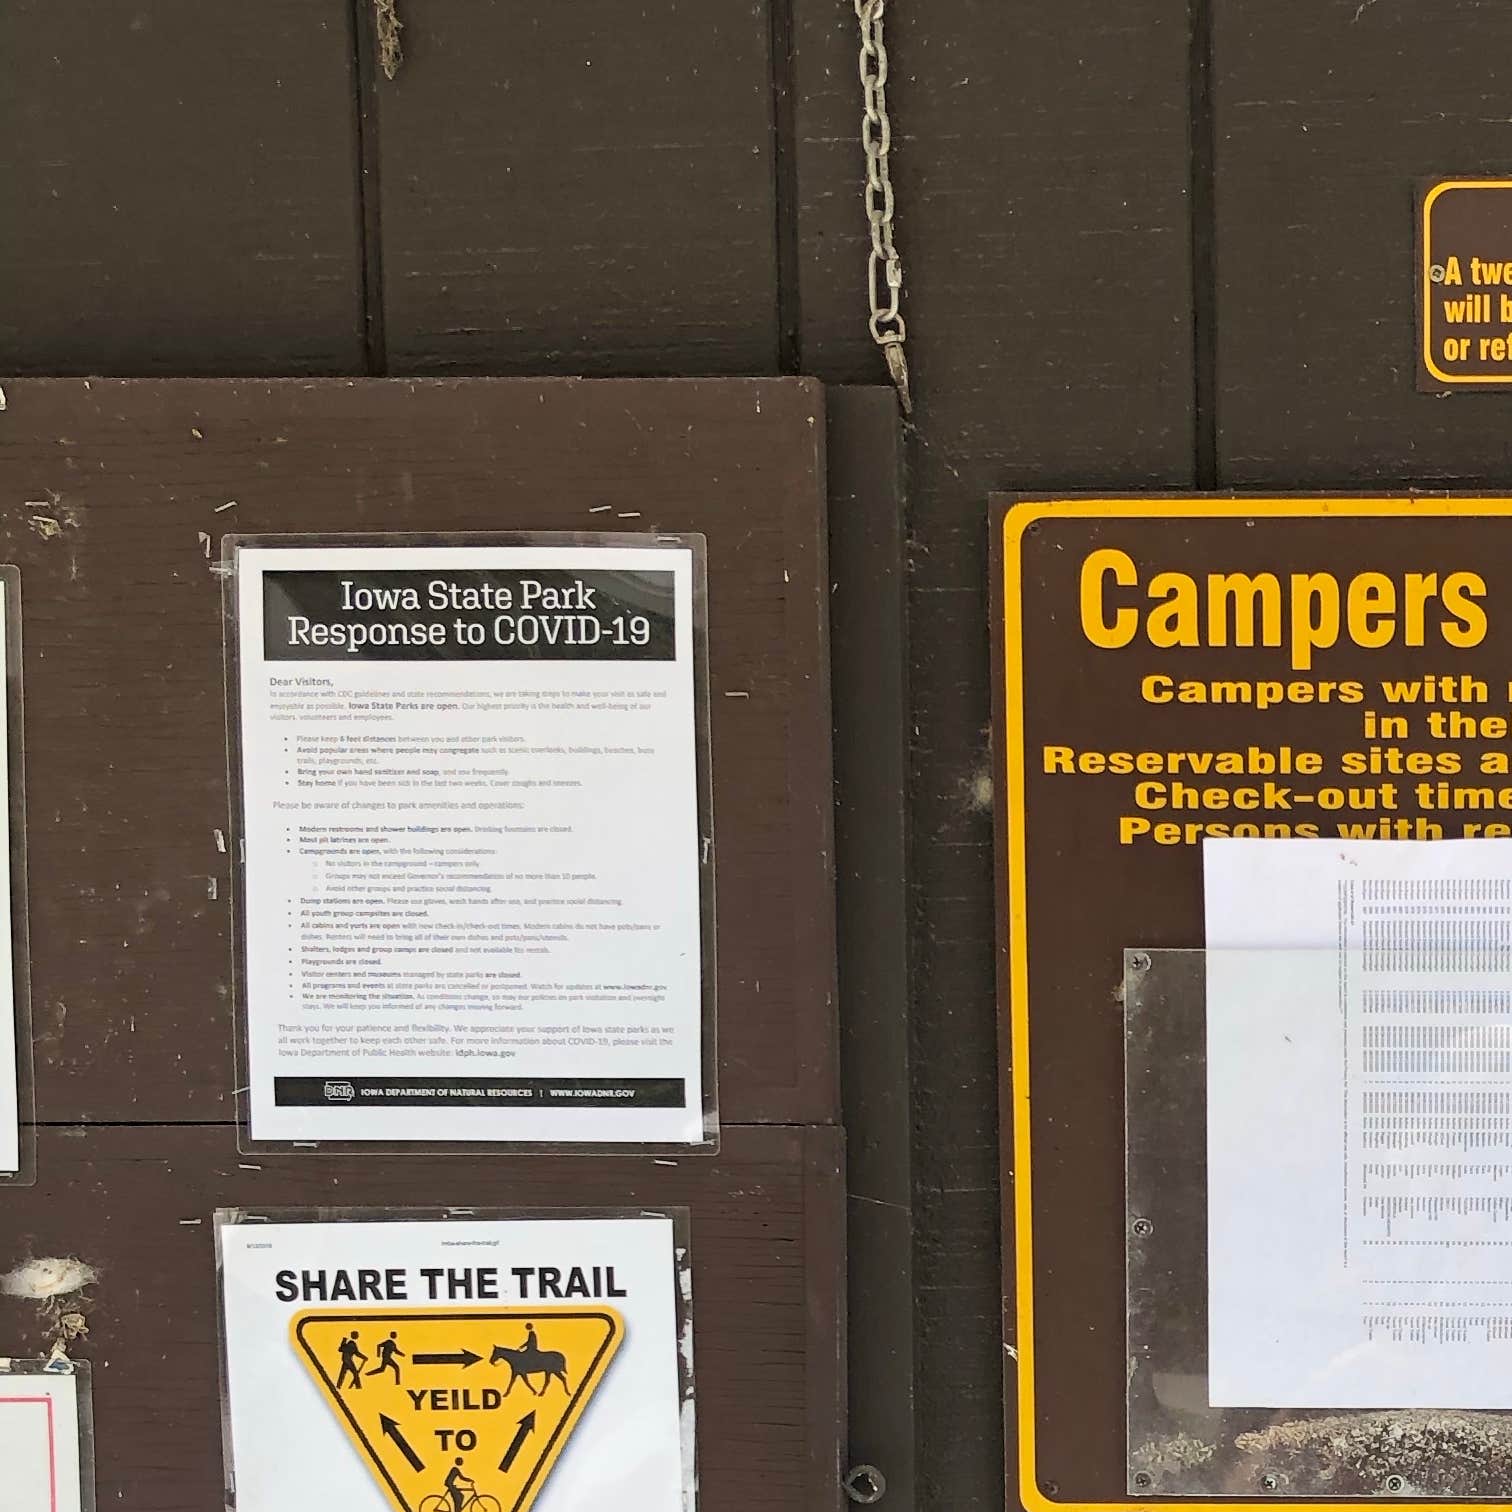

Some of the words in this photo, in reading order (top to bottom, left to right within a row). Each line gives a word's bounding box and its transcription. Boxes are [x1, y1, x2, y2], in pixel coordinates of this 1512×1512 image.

[1443, 256, 1462, 285] A
[1444, 293, 1491, 323] will
[1443, 337, 1471, 362] or
[340, 580, 421, 611] Iowa
[428, 579, 514, 610] State
[520, 579, 597, 610] Park
[1080, 548, 1488, 671] Campers
[288, 616, 447, 652] Response
[453, 618, 486, 646] to
[493, 615, 651, 646] COVID-19
[269, 676, 293, 687] Dear
[295, 676, 334, 688] Visitors,
[1141, 674, 1364, 710] Campers
[1382, 674, 1488, 703] with
[348, 702, 370, 710] Iowa
[372, 702, 394, 710] State
[396, 702, 419, 710] Parks
[437, 703, 460, 713] open.
[1364, 710, 1408, 739] in
[1043, 745, 1323, 775] Reservable
[1341, 746, 1462, 775] sites
[1135, 781, 1398, 810] Check-out
[1119, 816, 1317, 845] Persons
[1338, 817, 1443, 841] with
[324, 1083, 355, 1100] DNR
[360, 1088, 384, 1097] IOWA
[385, 1088, 436, 1097] DEPARTMENT
[437, 1088, 448, 1097] OF
[449, 1088, 486, 1098] NATURAL
[487, 1089, 533, 1098] RESOURCES
[549, 1089, 635, 1099] WWW.IOWADNR.GOV
[275, 1269, 408, 1302] SHARE
[420, 1268, 499, 1300] THE
[511, 1266, 628, 1299] TRAIL
[407, 1389, 502, 1411] YEILD
[434, 1429, 477, 1451] TO
